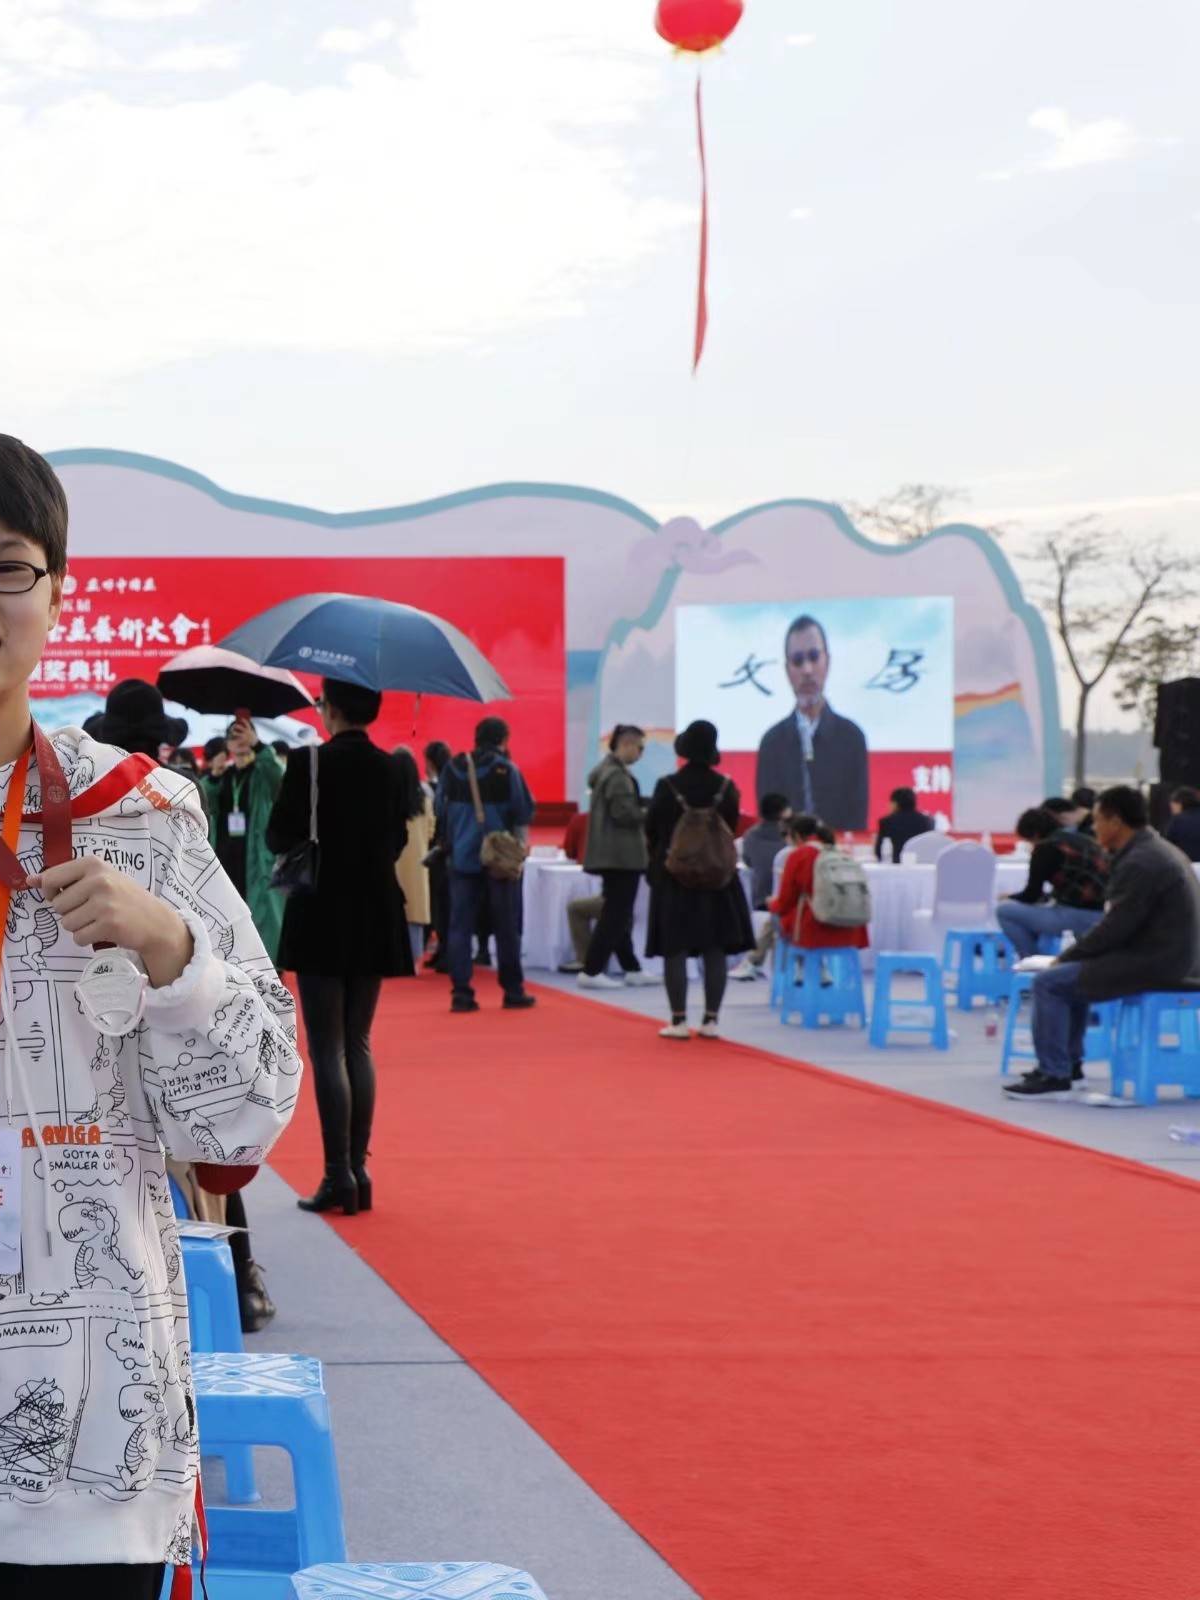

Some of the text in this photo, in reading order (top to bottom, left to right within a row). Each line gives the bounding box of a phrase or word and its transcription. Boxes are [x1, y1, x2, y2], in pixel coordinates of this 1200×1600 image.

[912, 764, 952, 793] 支持
[102, 838, 118, 847] THE
[219, 997, 254, 1049] SPRINKLES
[240, 1013, 255, 1038] WITH
[162, 1064, 226, 1088] COME HERE
[168, 1075, 227, 1097] ALL RIGHT
[62, 1149, 99, 1159] GOTTA
[49, 1161, 98, 1171] SMALLER
[10, 1474, 43, 1490] SCARE
